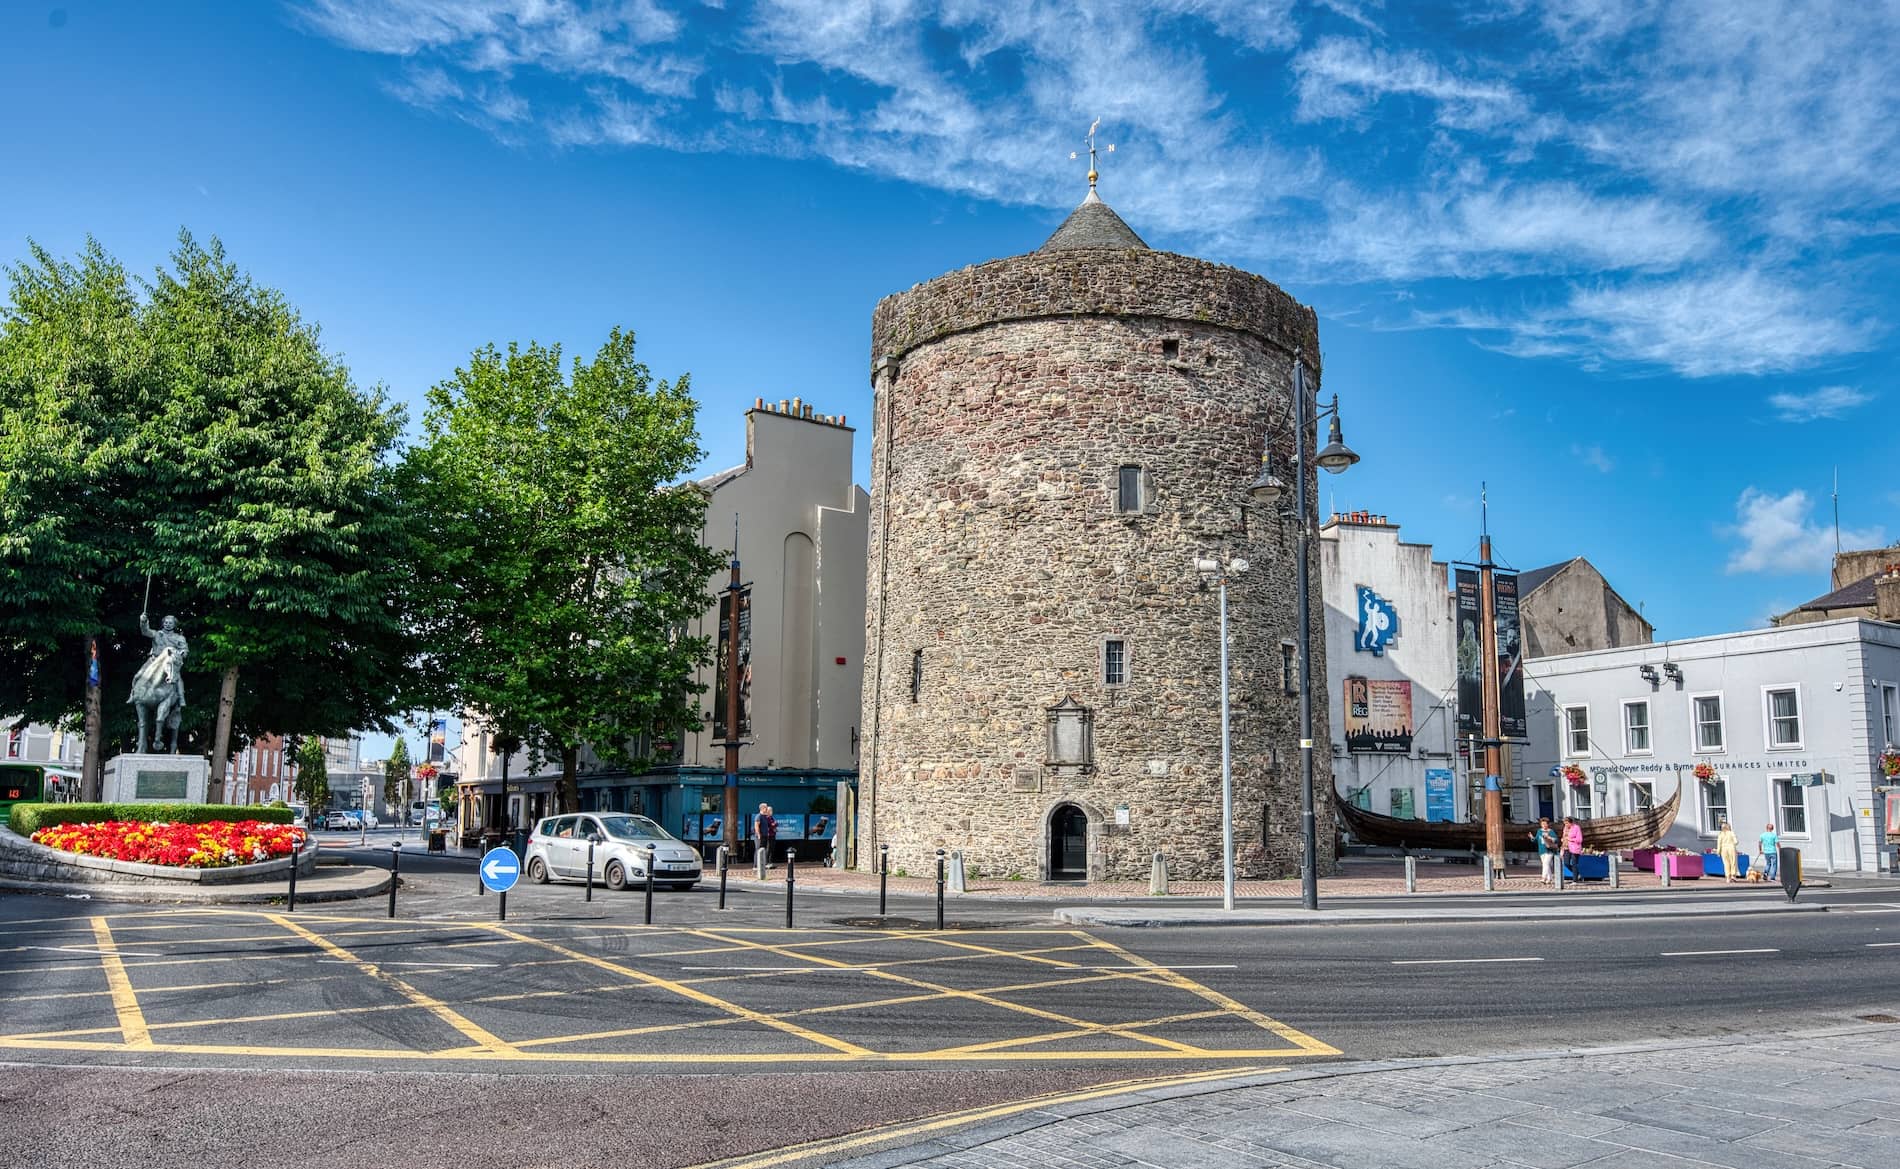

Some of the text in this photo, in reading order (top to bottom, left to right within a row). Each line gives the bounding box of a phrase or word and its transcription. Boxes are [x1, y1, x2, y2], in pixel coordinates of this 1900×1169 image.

[1353, 707, 1368, 716] REG
[1619, 765, 1639, 774] Dwyer
[1640, 764, 1663, 773] Reddy
[1673, 763, 1694, 772] Byrne
[1713, 760, 1761, 770] SURANCES
[1767, 760, 1807, 768] LIMITED
